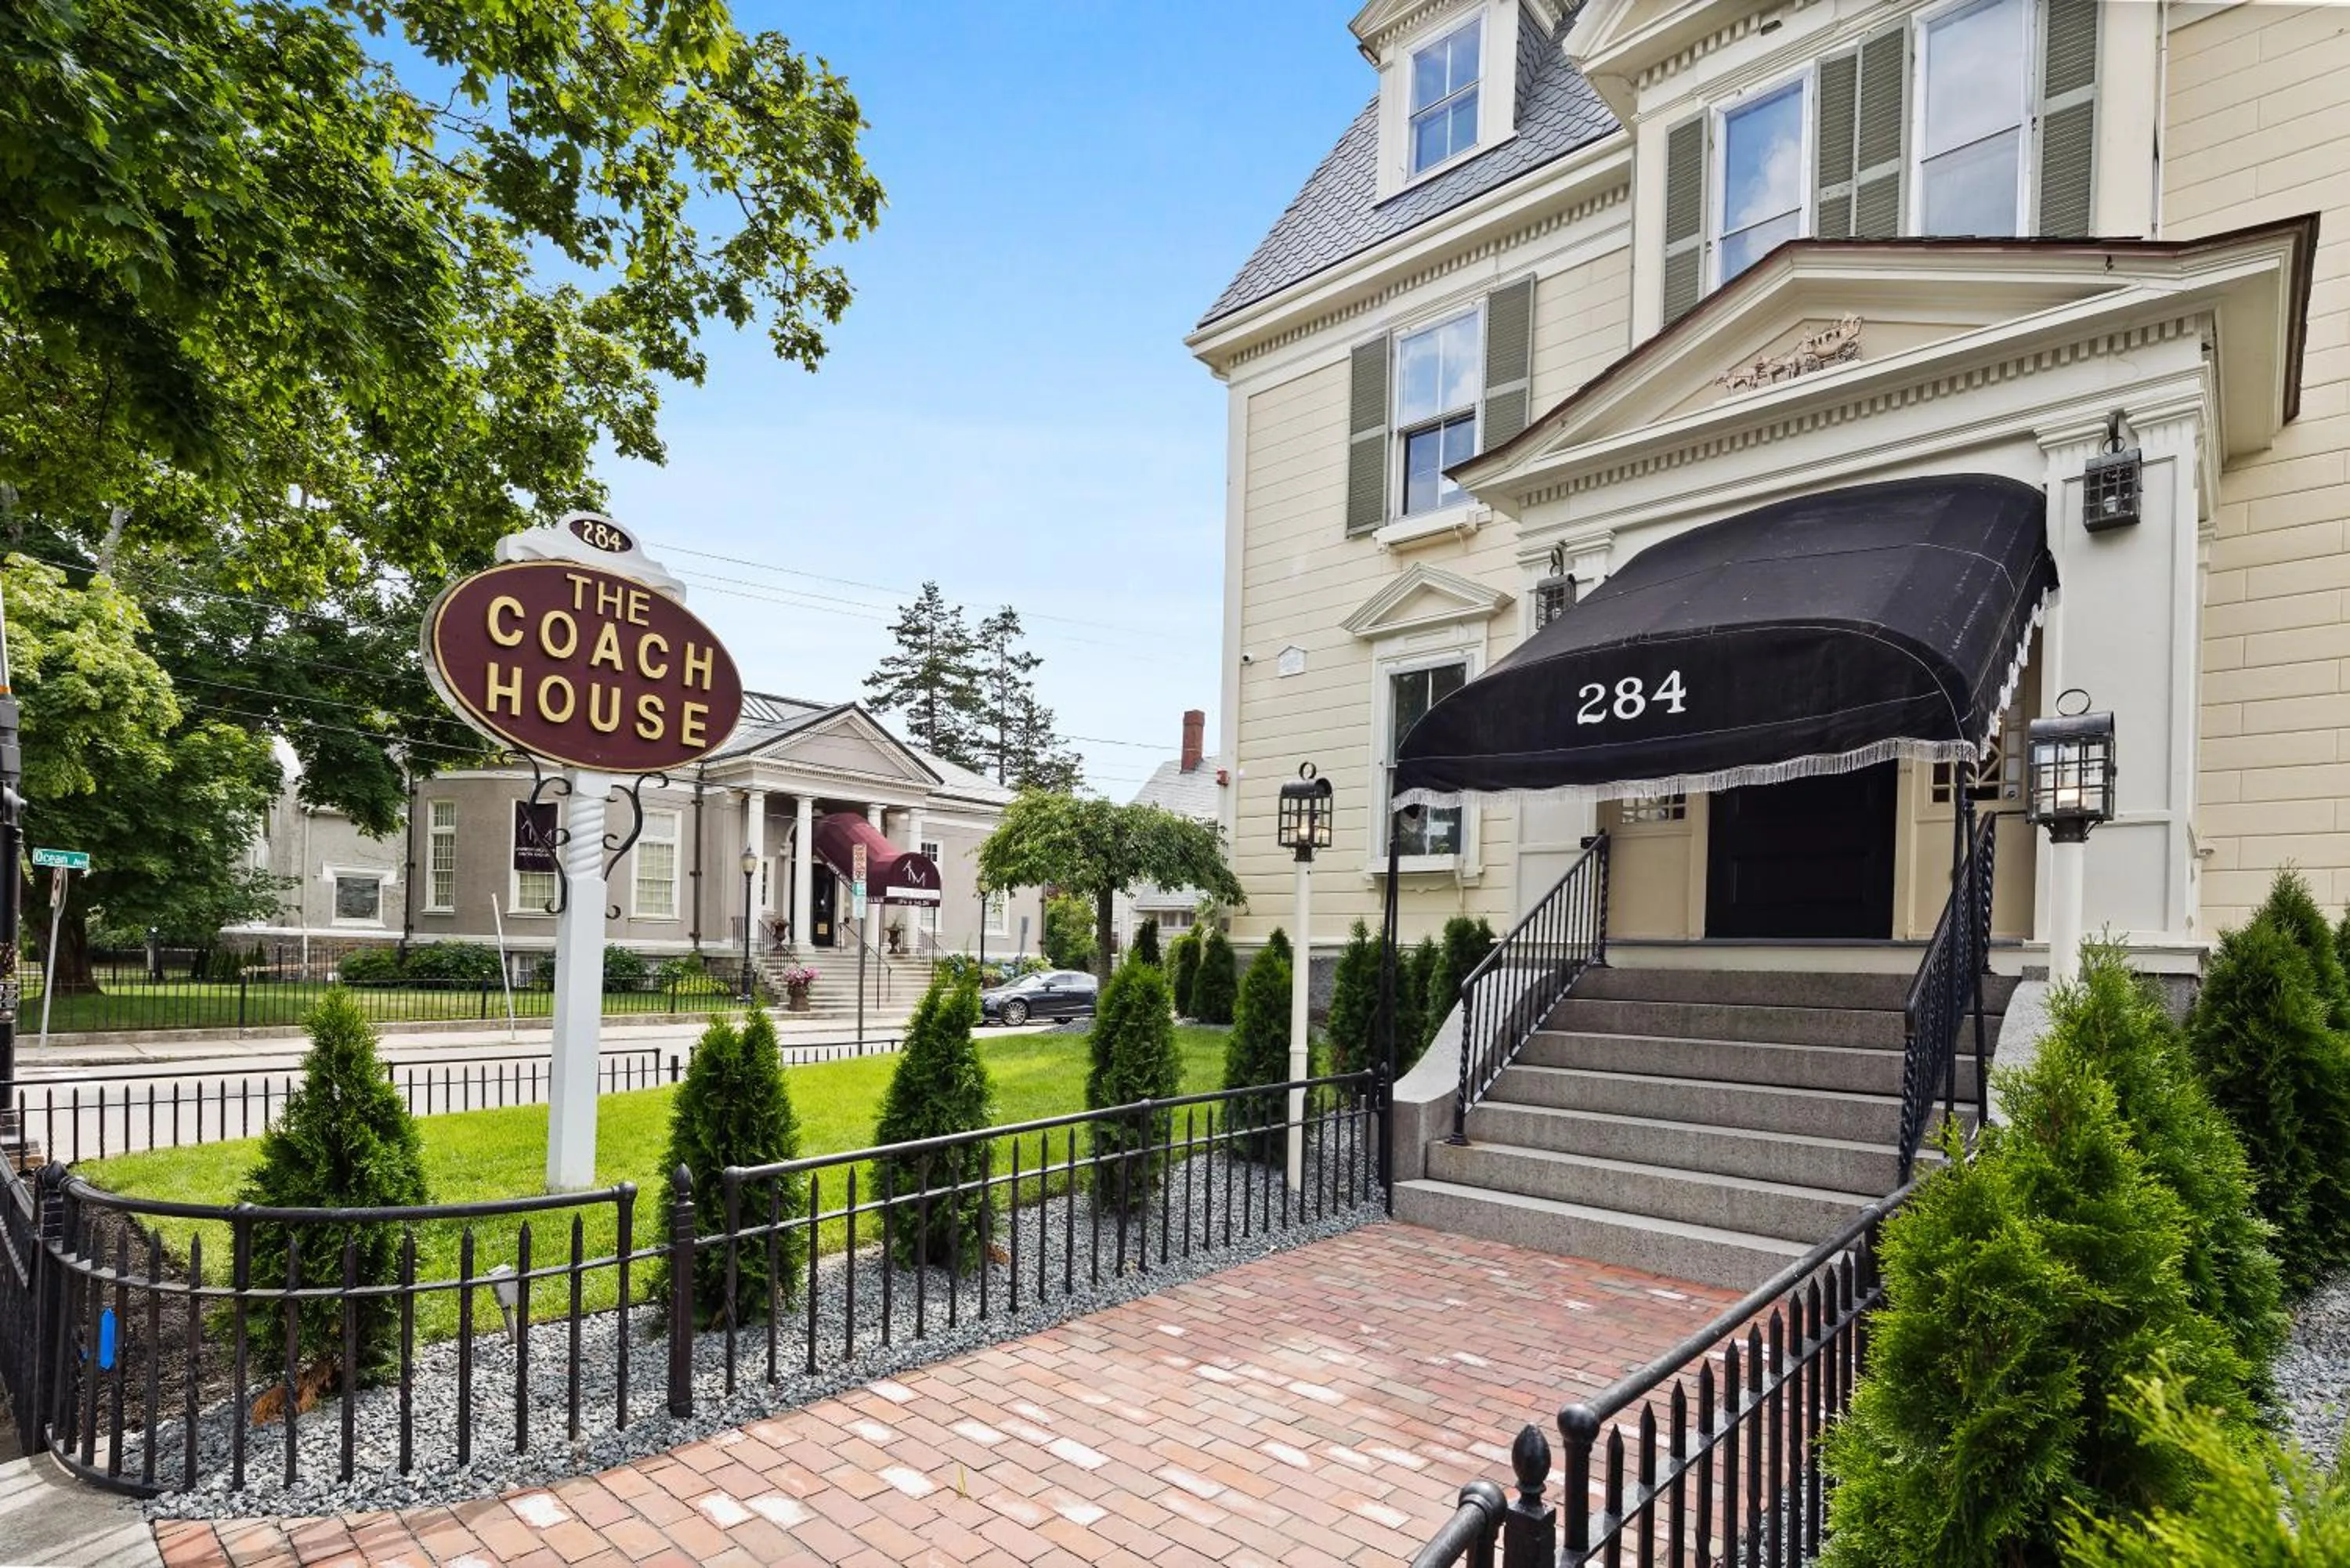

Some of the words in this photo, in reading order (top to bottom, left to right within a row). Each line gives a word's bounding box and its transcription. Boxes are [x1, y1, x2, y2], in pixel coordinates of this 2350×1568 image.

[583, 521, 621, 551] 284
[566, 573, 651, 627] THE
[487, 595, 714, 691] COACH
[485, 662, 710, 749] HOUSE
[1577, 670, 1687, 725] 284
[35, 851, 68, 865] Ocean
